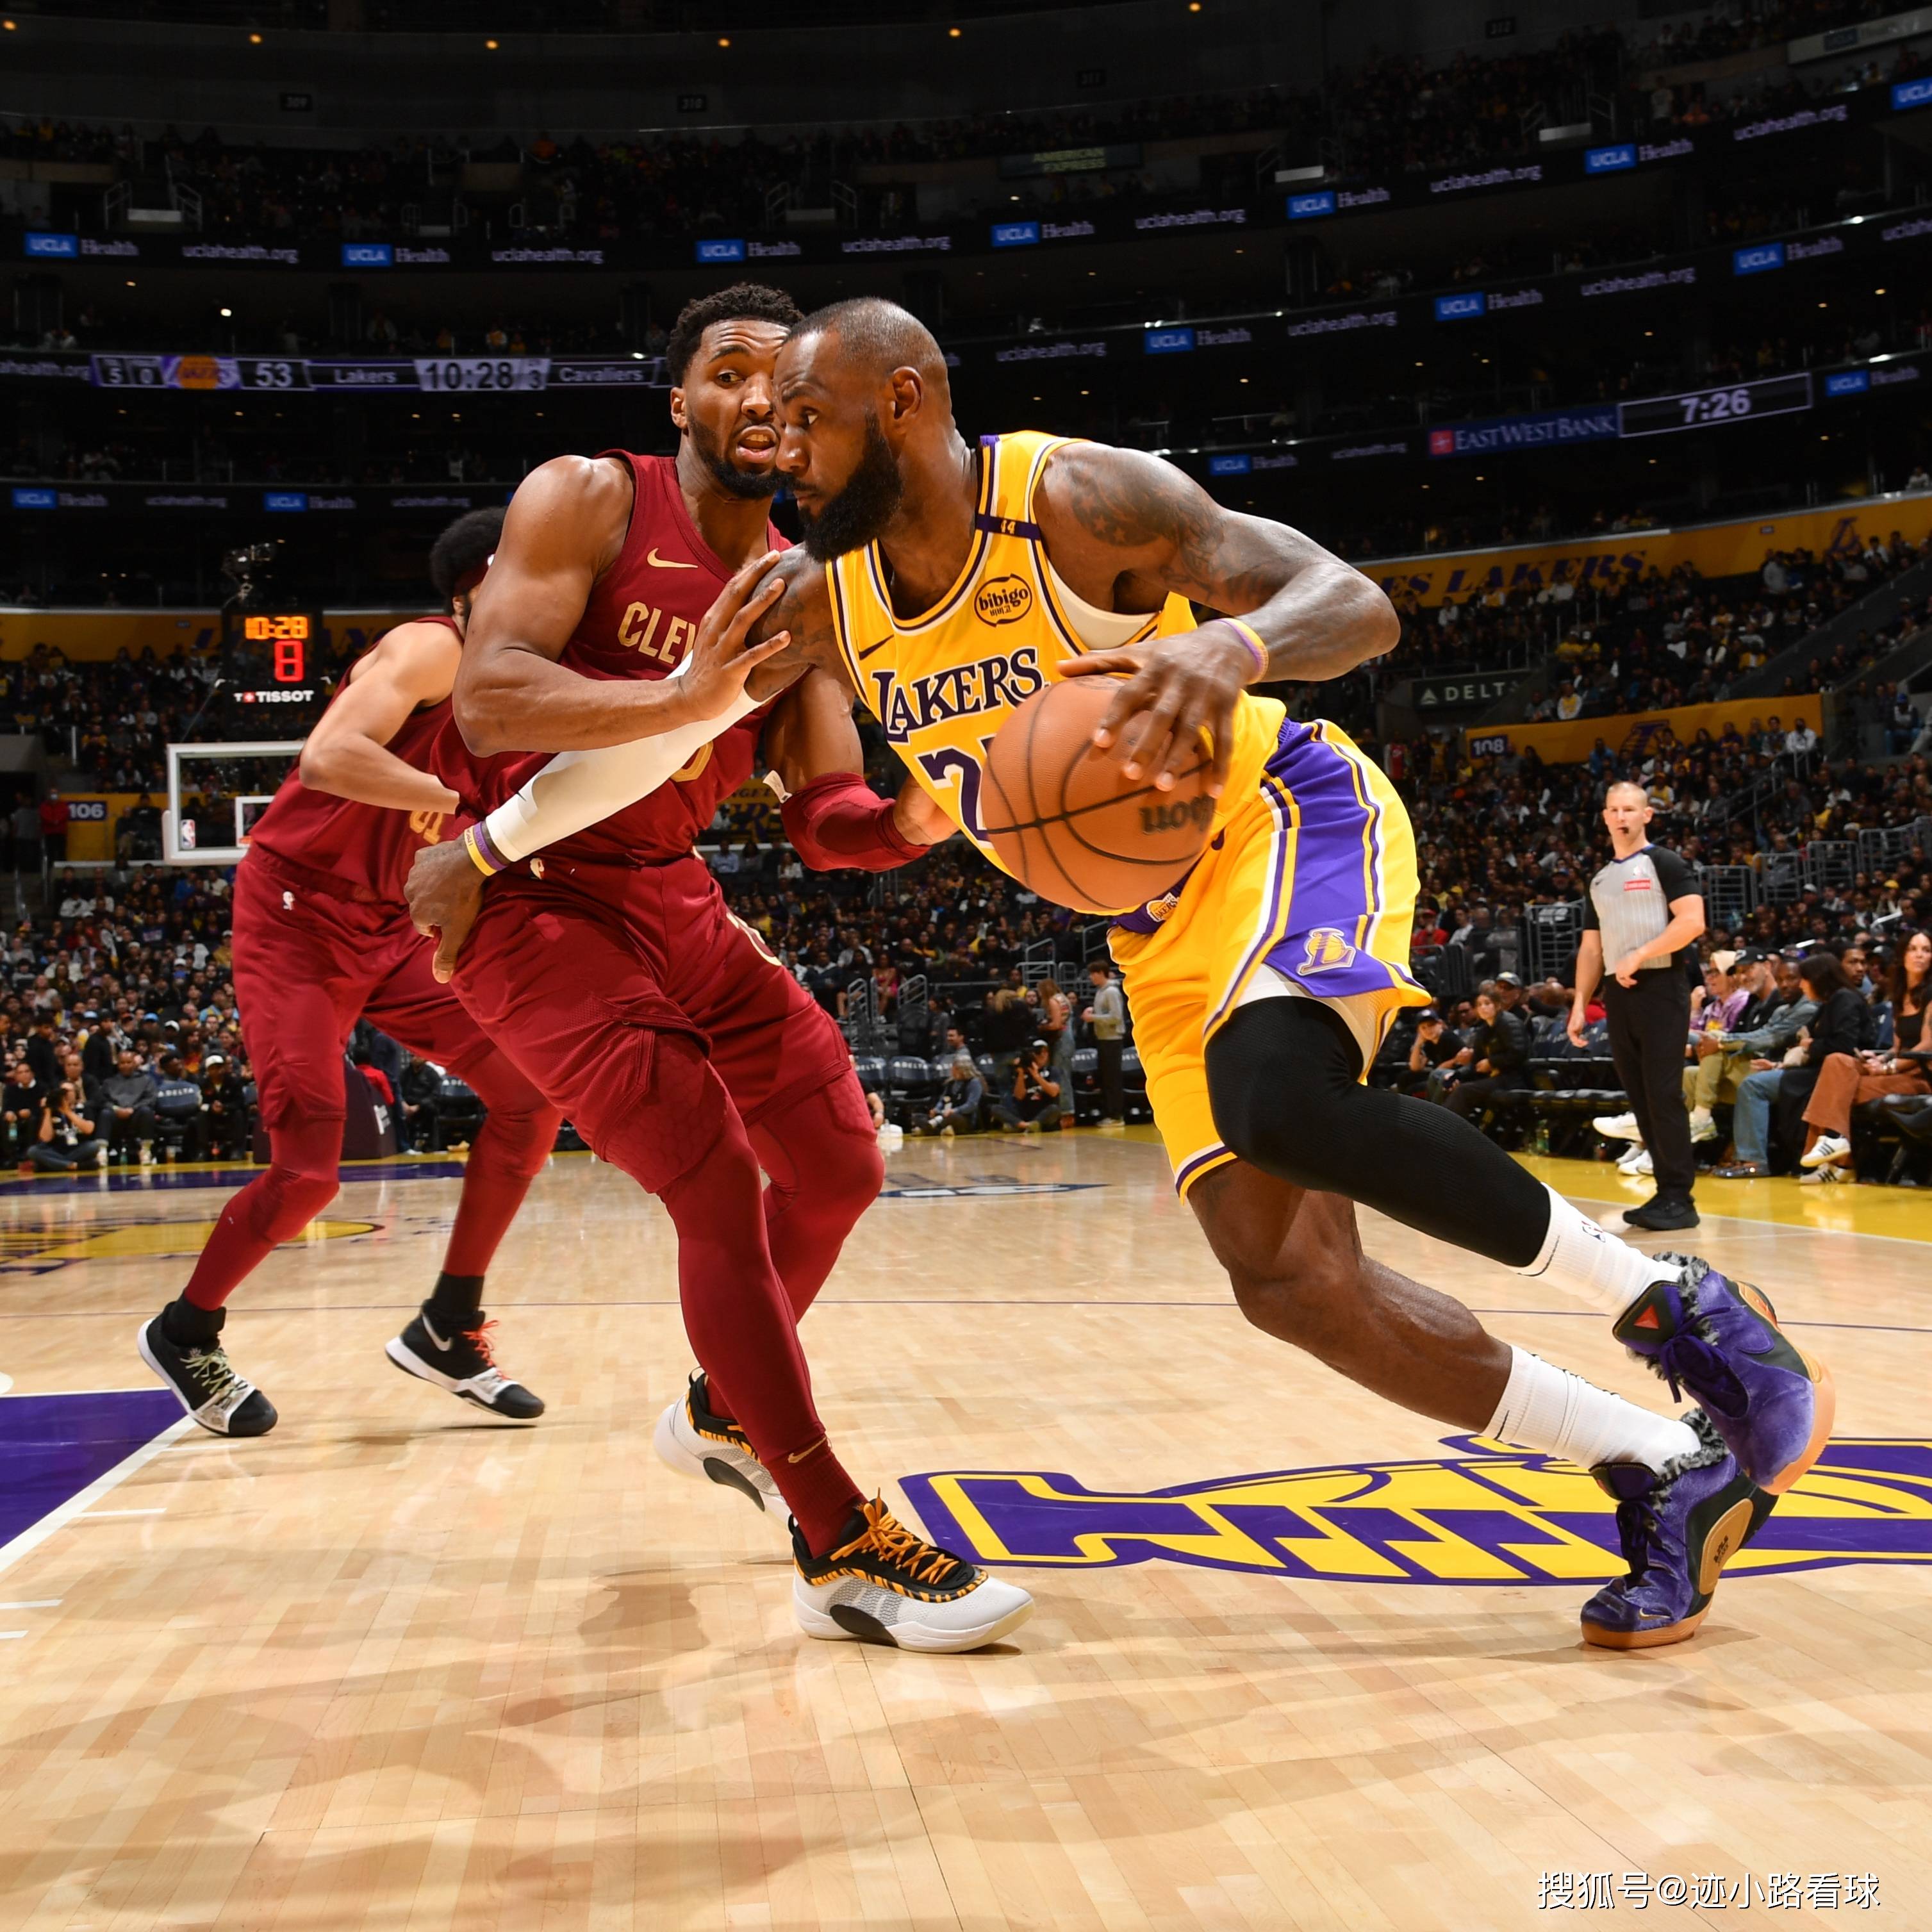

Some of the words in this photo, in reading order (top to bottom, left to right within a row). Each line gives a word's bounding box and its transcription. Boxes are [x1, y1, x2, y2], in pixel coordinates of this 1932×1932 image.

[1733, 104, 1847, 140] uclahealth.org
[1590, 151, 1630, 167] UCLA
[1639, 138, 1694, 161] Health
[1430, 165, 1542, 192] uclahealth.org
[1292, 197, 1330, 213] UCLA
[1337, 187, 1391, 208] Health
[1135, 208, 1246, 229] uclahealth.org
[996, 227, 1034, 242] UCLA
[1041, 220, 1095, 239] Health
[30, 238, 72, 251] UCLA
[80, 238, 140, 256] Health
[181, 243, 299, 264] uclahealth.org
[702, 244, 739, 257] UCLA
[747, 241, 801, 257] Health
[841, 235, 952, 253] uclahealth.org
[1738, 249, 1779, 268] UCLA
[1786, 235, 1844, 261] Health
[347, 248, 385, 262] UCLA
[394, 247, 450, 263] Health
[491, 247, 604, 265] uclahealth.org
[1580, 267, 1696, 297] uclahealth.org
[1441, 299, 1478, 315] UCLA
[1487, 288, 1544, 310] Health
[1287, 311, 1398, 336] uclahealth.org
[1150, 334, 1189, 348] UCLA
[1196, 327, 1251, 346] Health
[995, 342, 1107, 362] uclahealth.org
[109, 368, 122, 384] 5
[139, 368, 153, 384] 0
[255, 361, 292, 386] 53
[334, 368, 397, 384] Lakers
[425, 362, 513, 388] 10:28
[529, 370, 541, 388] 3
[559, 367, 643, 382] Cavaliers
[1830, 377, 1863, 391] UCLA
[1870, 365, 1920, 385] Health
[1680, 389, 1752, 424] 7:26
[1213, 459, 1245, 472] UCLA
[1251, 454, 1298, 470] Health
[15, 493, 52, 504] UCLA
[268, 497, 301, 508] UCLA
[308, 495, 356, 509] Health
[1000, 520, 1016, 534] 44
[978, 588, 1028, 611] bibigo
[245, 616, 308, 640] 10:28
[274, 640, 304, 682] 8
[255, 689, 314, 703] TISSOT
[871, 647, 1045, 743] LAKERS
[1472, 737, 1505, 757] 108
[69, 803, 104, 818] 106
[1151, 898, 1178, 921] LAKERS
[165, 1087, 194, 1097] DELTA
